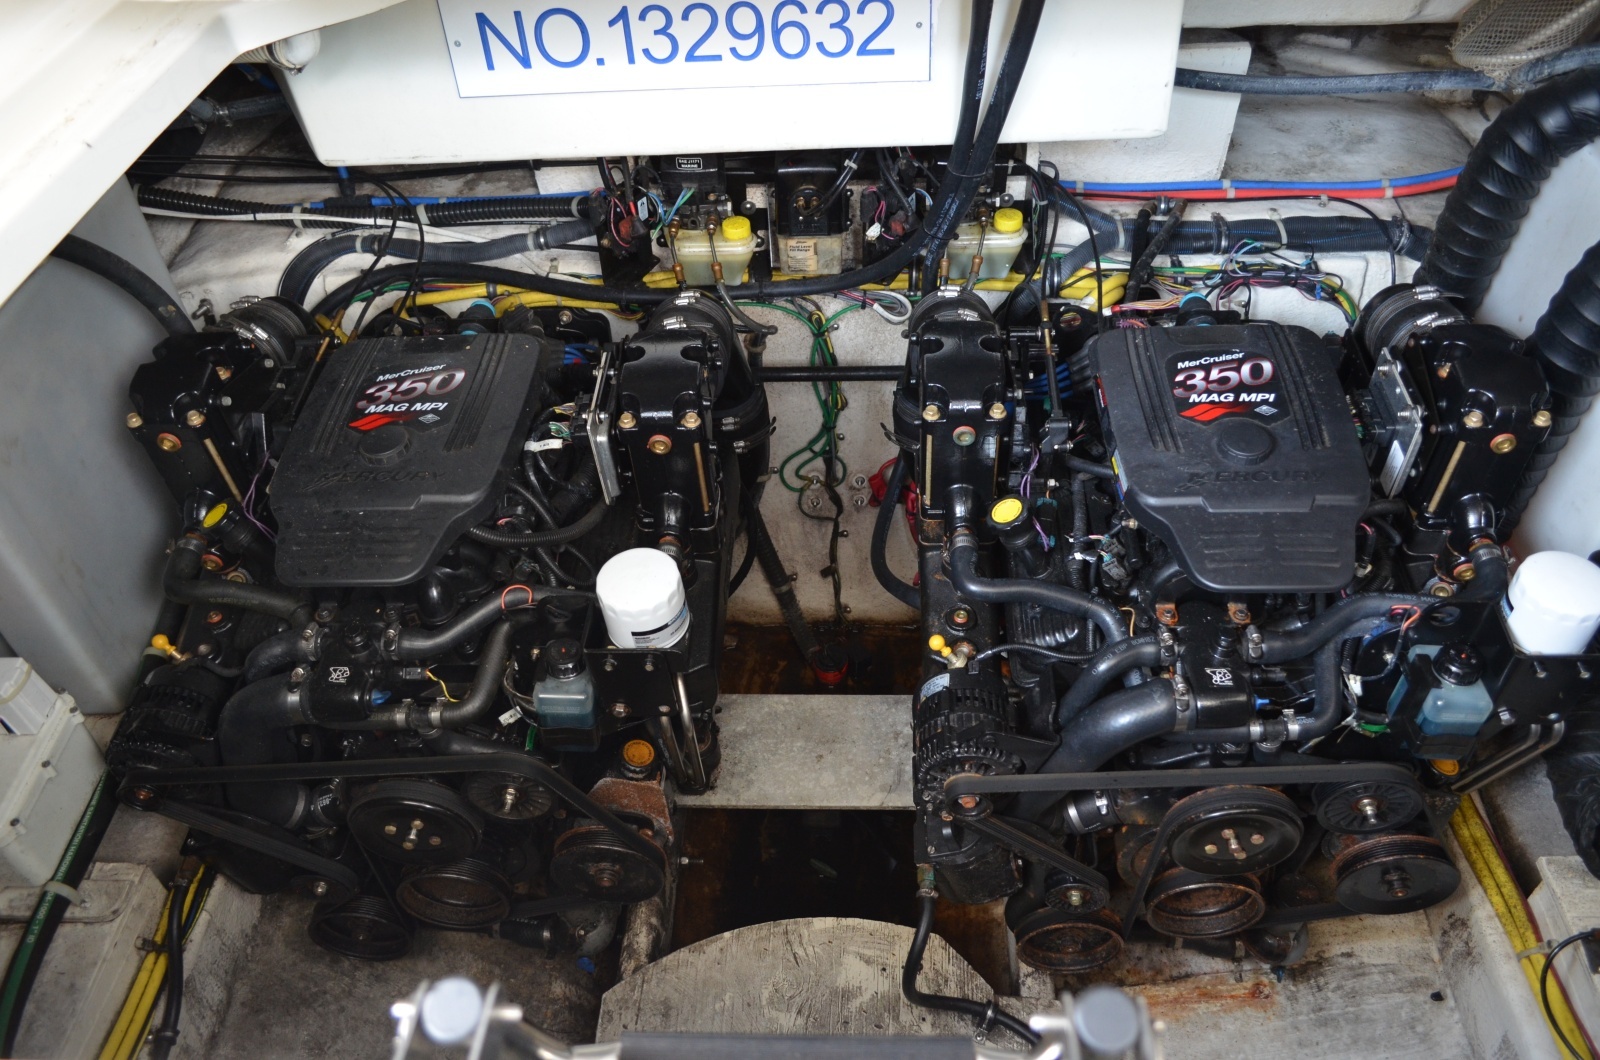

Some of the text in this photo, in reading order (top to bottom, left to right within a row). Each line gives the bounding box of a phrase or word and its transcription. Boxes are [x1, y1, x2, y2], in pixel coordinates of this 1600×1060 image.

[475, 0, 895, 71] NO.1329632
[376, 364, 447, 382] MerCruiser
[1173, 357, 1274, 398] 350
[1177, 352, 1245, 369] MerCruiser
[356, 368, 466, 409] 350
[1188, 392, 1276, 402] MAG MPI
[364, 402, 449, 413] MAG MPI
[73, 806, 94, 844] SANITATION
[54, 845, 76, 881] HARDWAL
